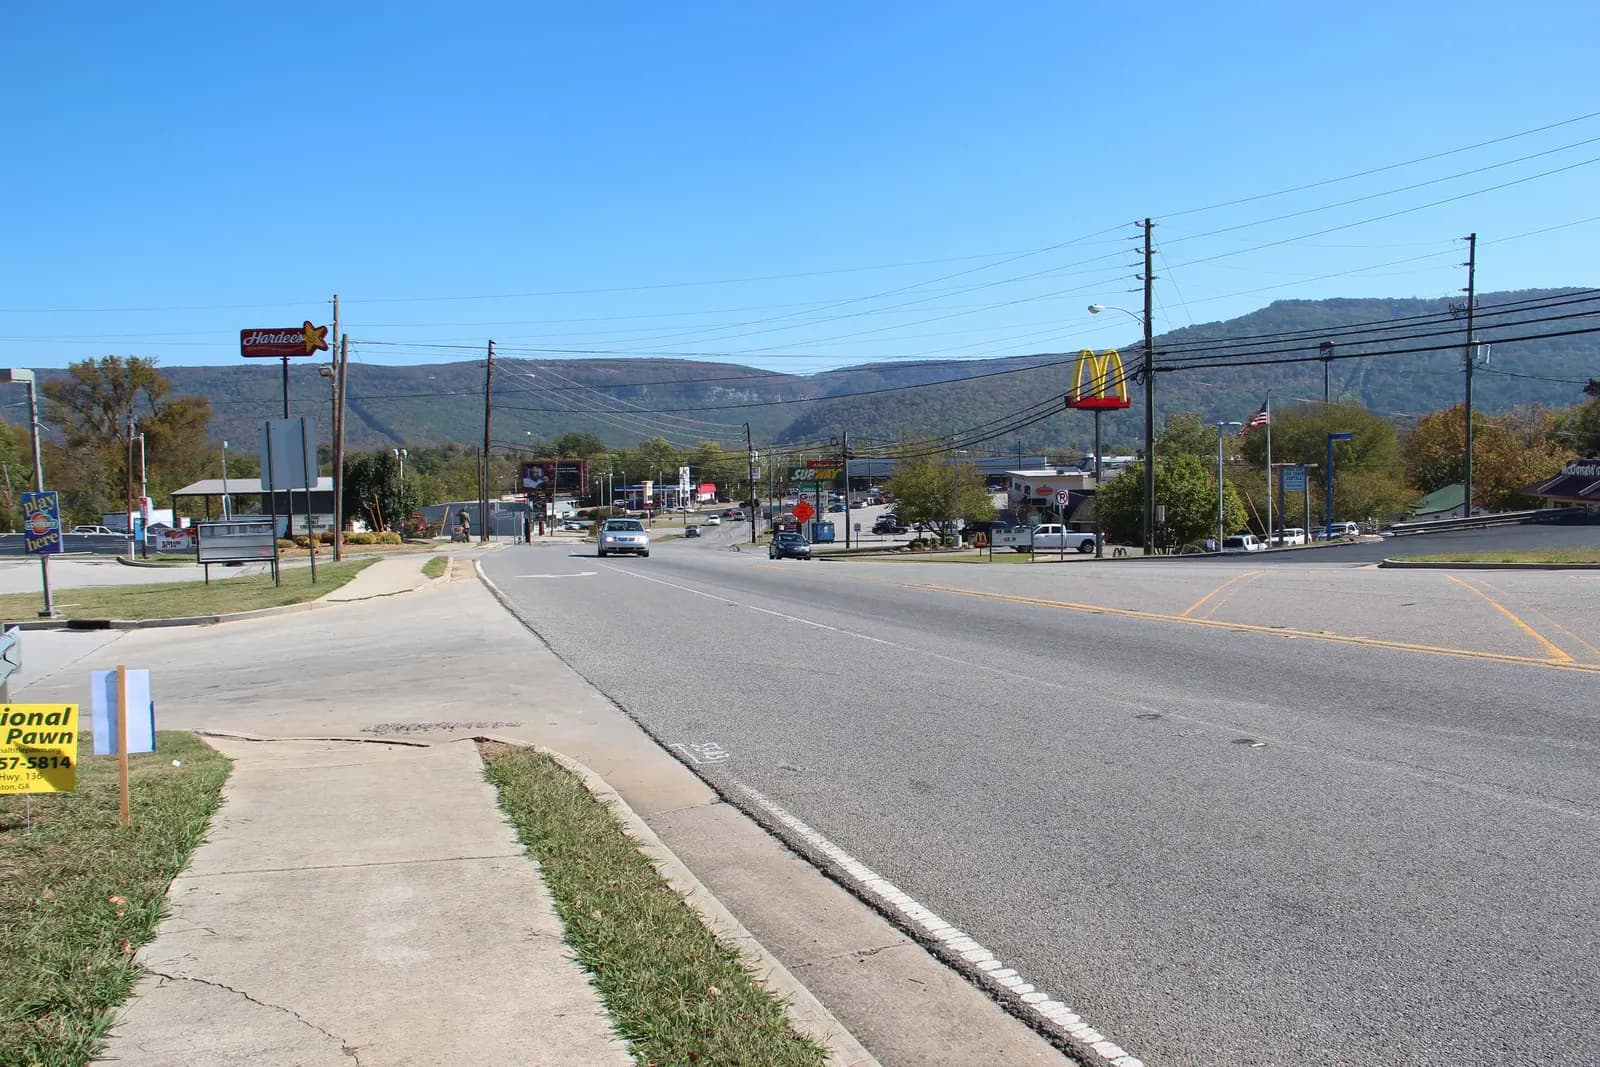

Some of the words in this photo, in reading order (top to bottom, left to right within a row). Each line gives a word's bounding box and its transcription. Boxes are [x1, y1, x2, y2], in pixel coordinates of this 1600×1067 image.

[243, 331, 304, 345] Hardee's
[791, 469, 843, 481] SUBWAY
[24, 495, 54, 517] play
[26, 533, 58, 552] here
[6, 728, 73, 745] Pawn
[0, 756, 71, 770] 57-5814
[0, 773, 22, 782] Hwy.
